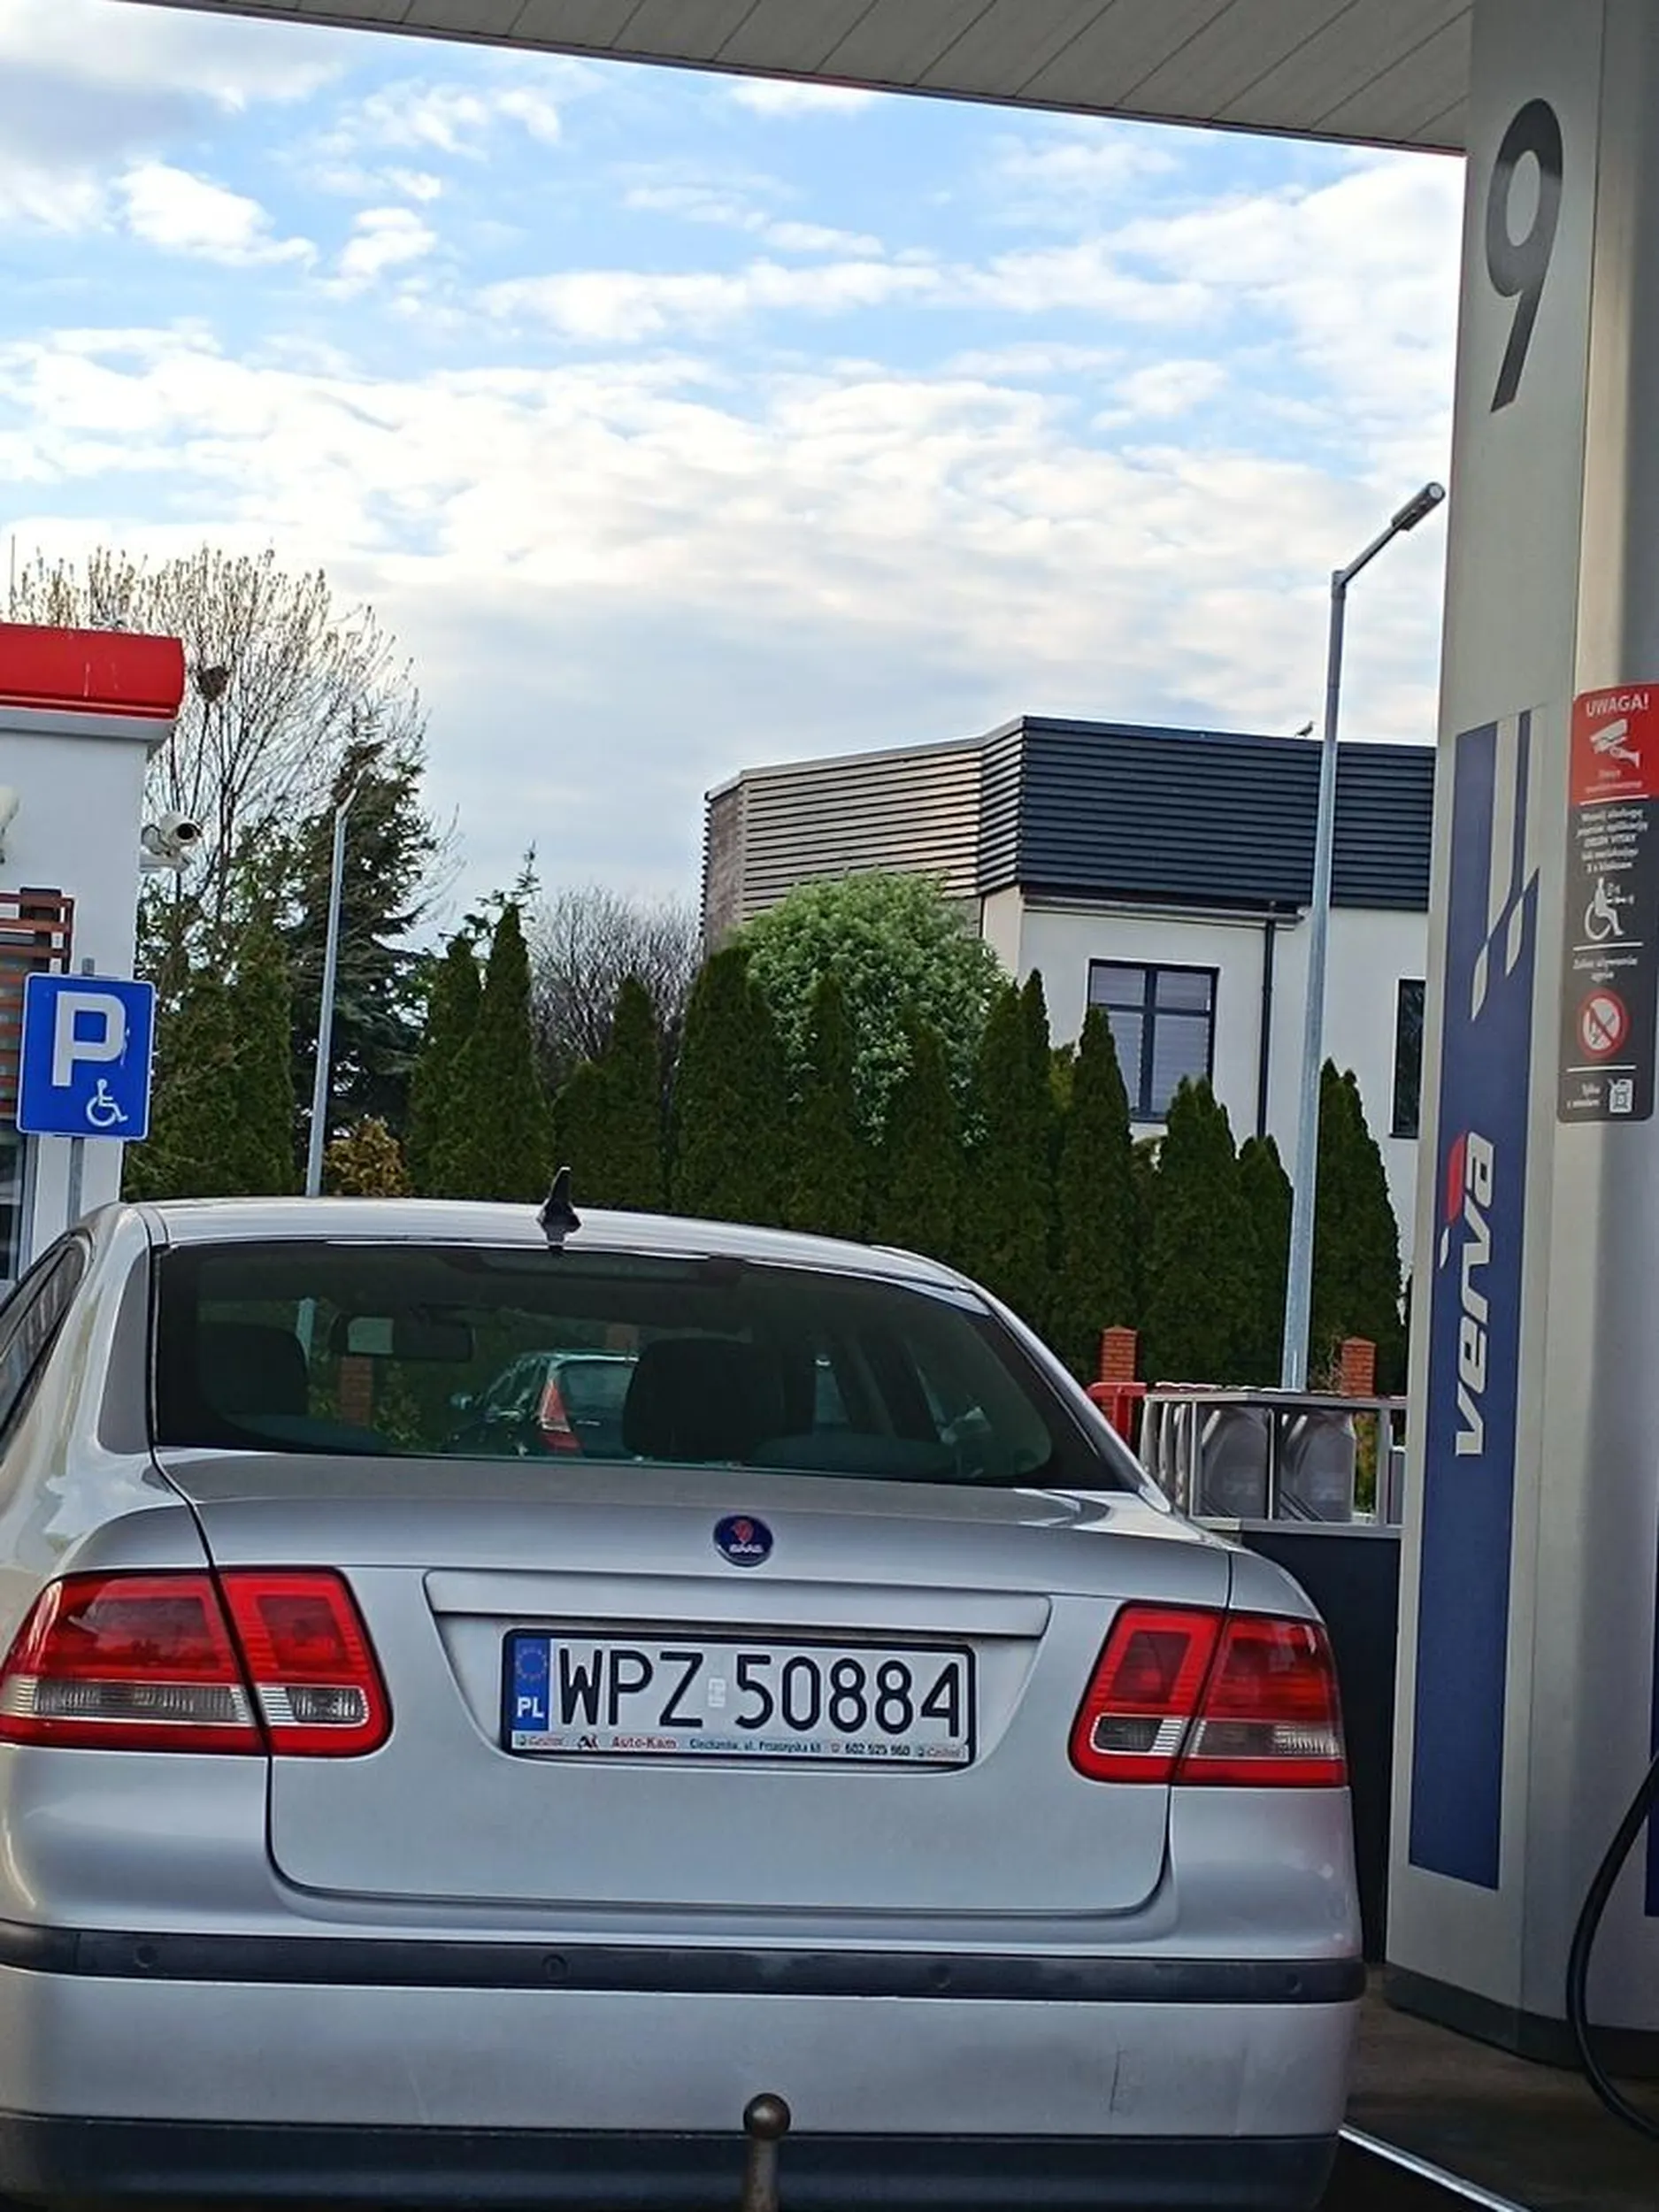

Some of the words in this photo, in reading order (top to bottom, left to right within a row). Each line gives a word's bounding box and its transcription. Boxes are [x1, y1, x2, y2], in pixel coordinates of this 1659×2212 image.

[1486, 97, 1563, 412] 9
[1586, 693, 1649, 718] UWAGA!
[52, 991, 125, 1087] P
[517, 1696, 544, 1719] PL
[558, 1648, 704, 1727] WPZ
[734, 1654, 960, 1738] 50884
[611, 1736, 677, 1749] Auto-Kam
